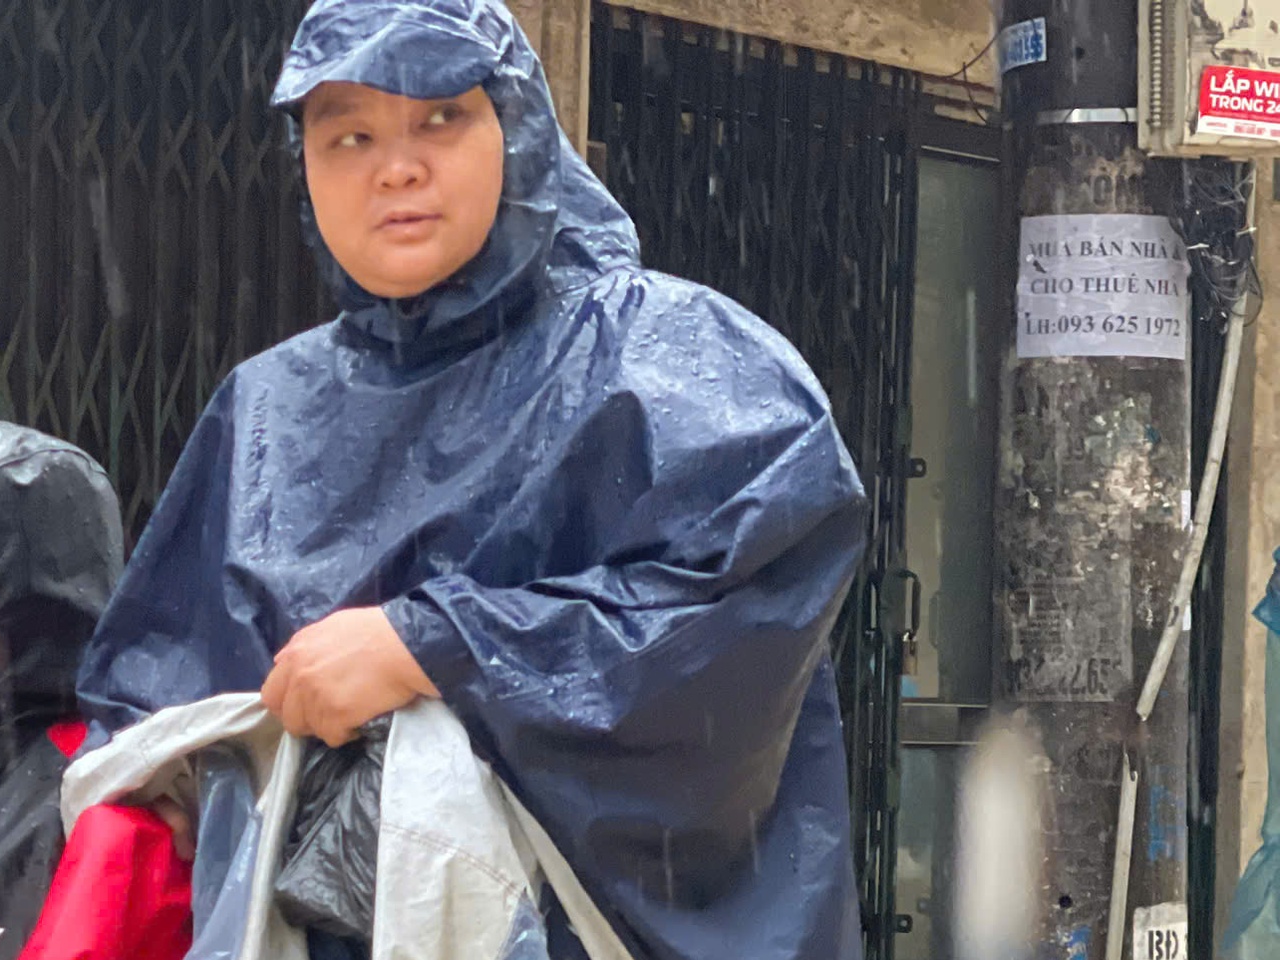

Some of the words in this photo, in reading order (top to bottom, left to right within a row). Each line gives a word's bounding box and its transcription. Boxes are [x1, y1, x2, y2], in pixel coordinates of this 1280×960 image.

[1209, 69, 1251, 94] LẮP
[1254, 79, 1280, 99] WI
[1209, 93, 1264, 113] TRONG
[1029, 241, 1072, 257] MUA
[1081, 236, 1123, 256] BÁN
[1131, 238, 1168, 259] NHÀ
[1031, 277, 1073, 295] CHO
[1081, 272, 1139, 294] THUÊ
[1026, 315, 1095, 336] LH:093
[1102, 314, 1138, 334] 625
[1146, 316, 1180, 337] 1972
